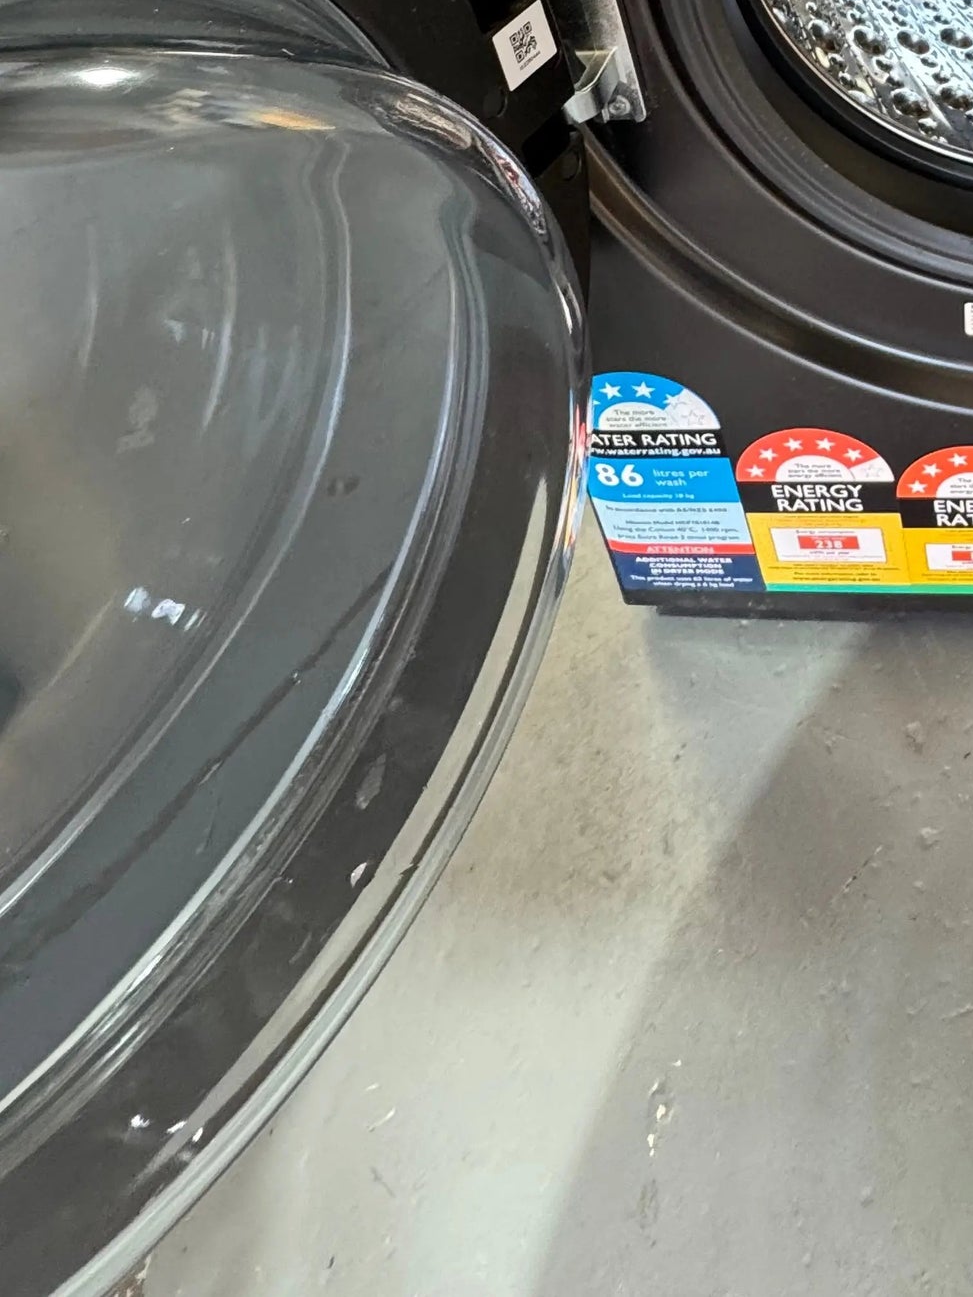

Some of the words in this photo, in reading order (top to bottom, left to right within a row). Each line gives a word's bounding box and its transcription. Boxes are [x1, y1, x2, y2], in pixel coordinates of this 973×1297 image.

[591, 433, 637, 447] ATER
[641, 432, 717, 446] RATING
[595, 462, 644, 487] 86
[652, 468, 685, 479] litres
[689, 470, 709, 480] per
[656, 478, 687, 487] wash
[770, 484, 863, 498] ENERGY
[776, 499, 864, 512] RATING
